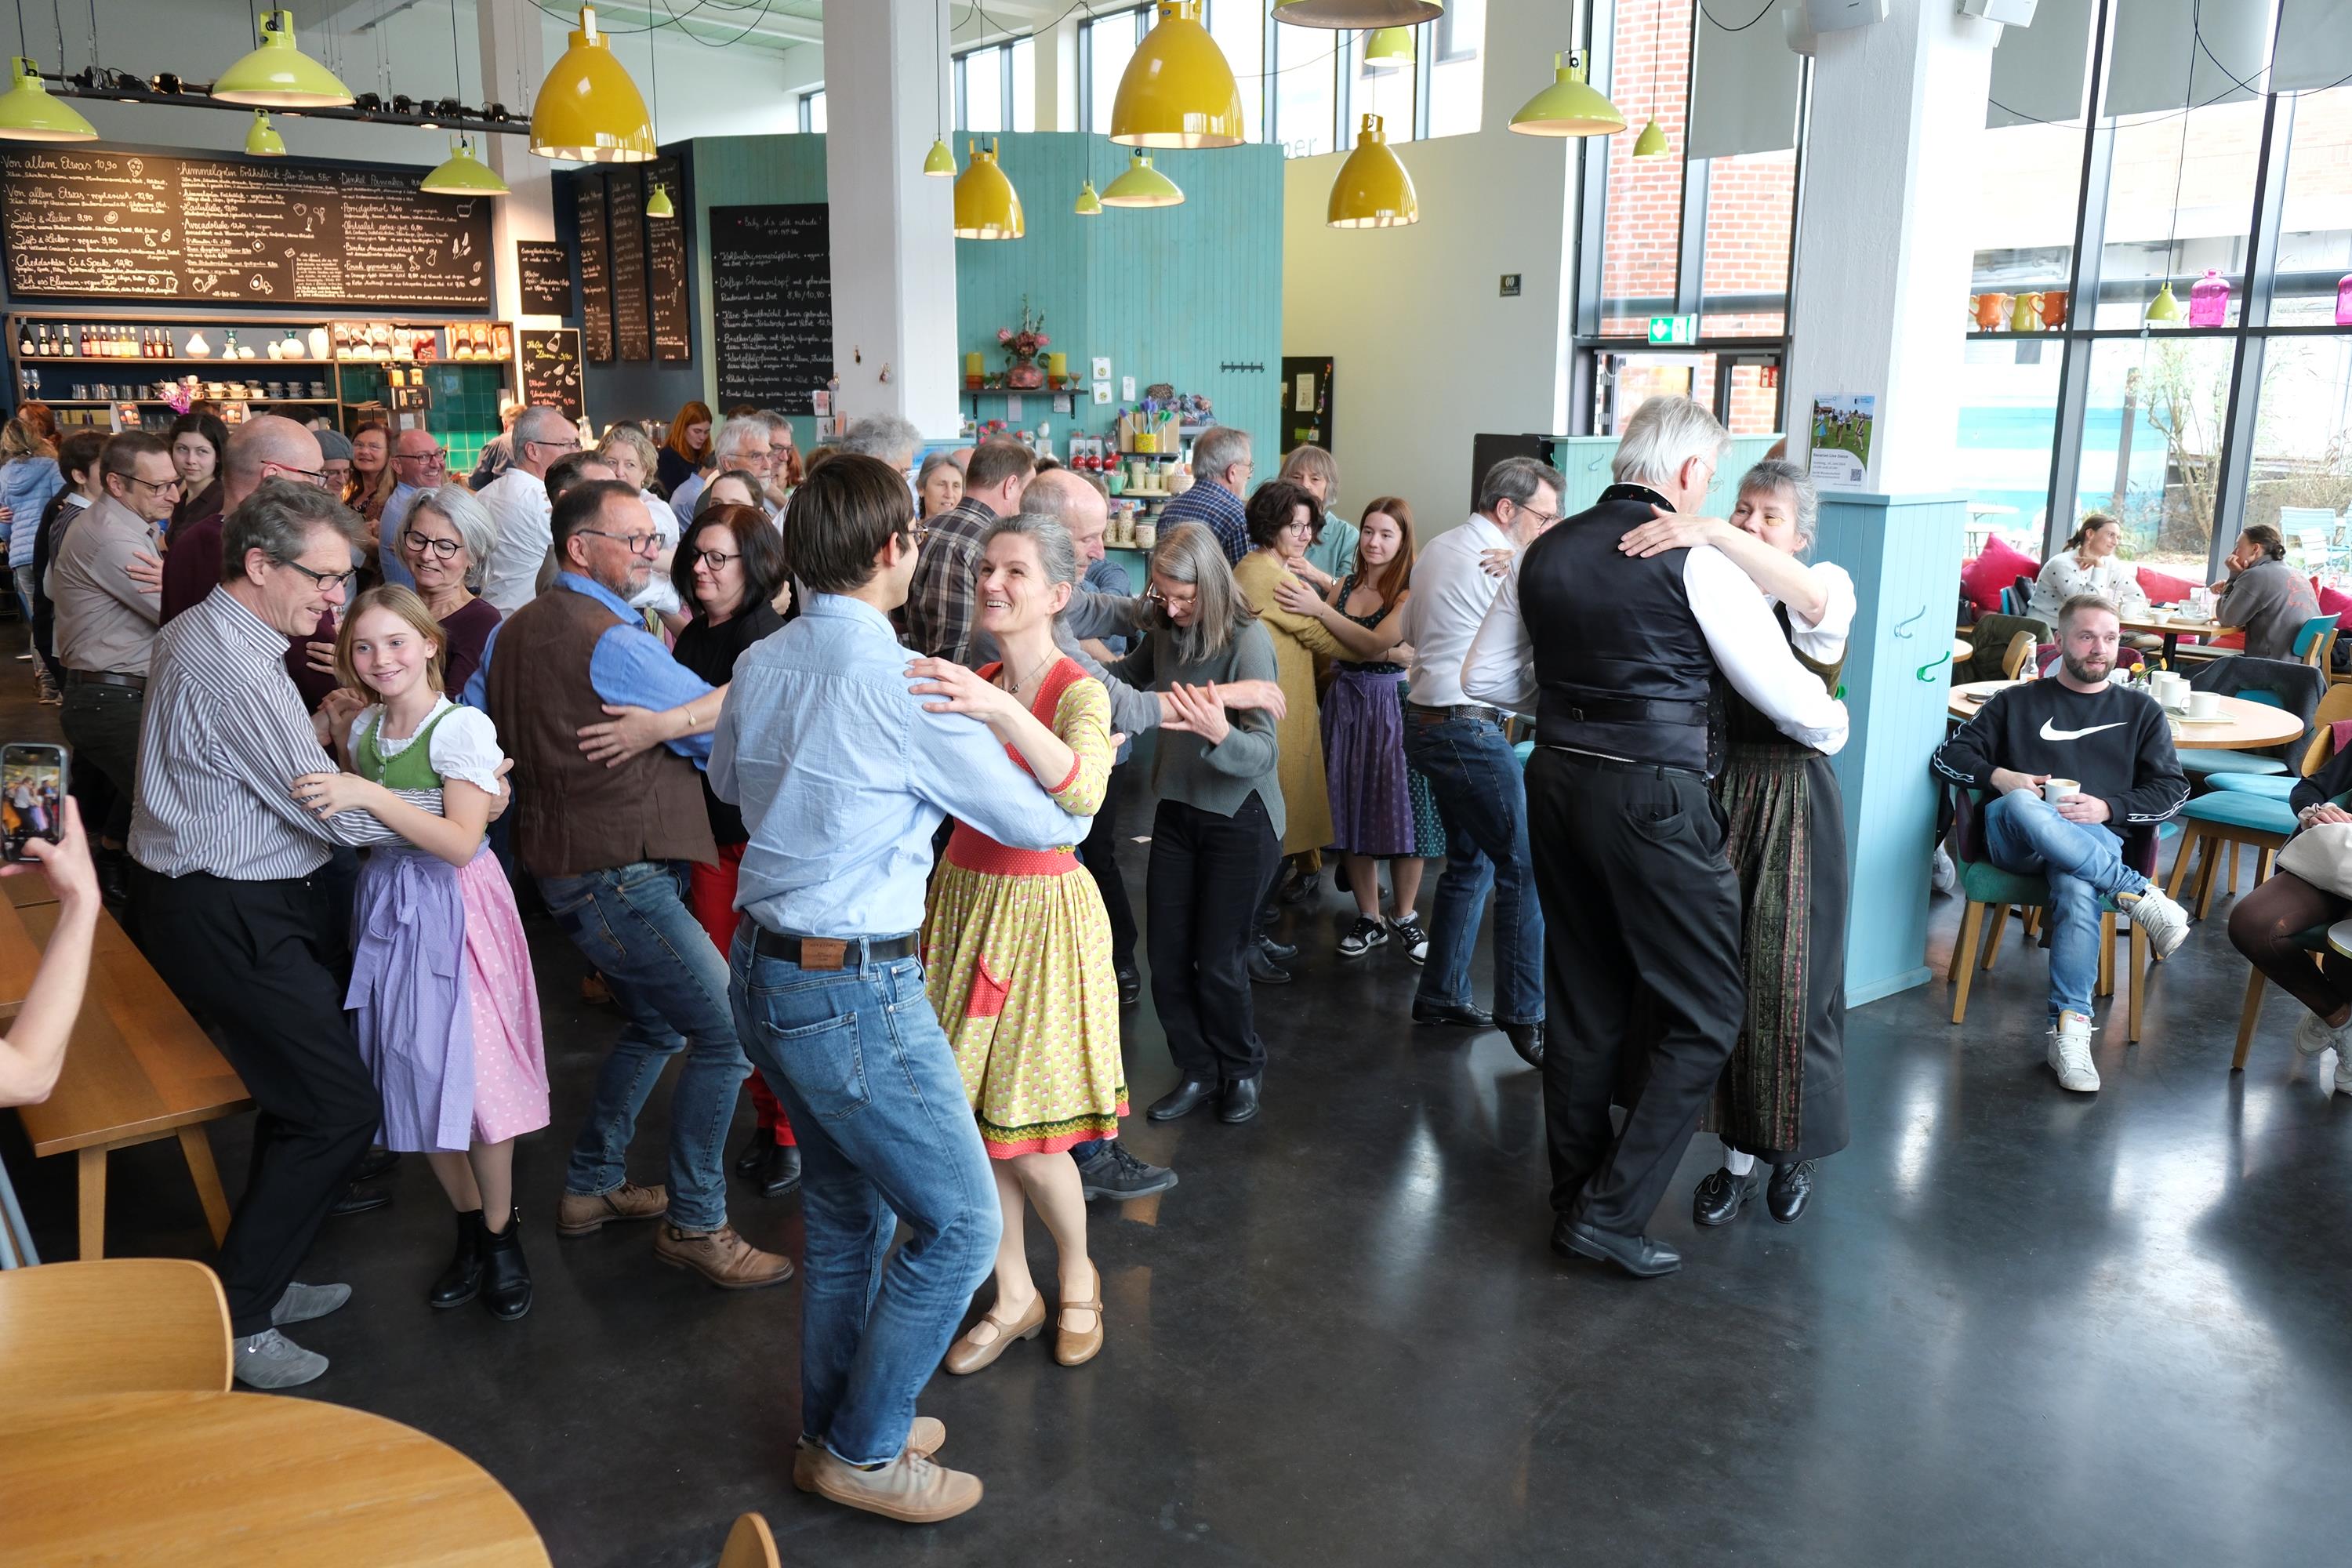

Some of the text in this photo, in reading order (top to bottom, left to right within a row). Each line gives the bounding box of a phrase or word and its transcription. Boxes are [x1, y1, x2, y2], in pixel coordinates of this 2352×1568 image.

[2, 155, 22, 169] Von
[26, 155, 57, 169] allem
[95, 159, 117, 172] 10,90
[5, 183, 26, 198] Von
[29, 187, 55, 199] allem
